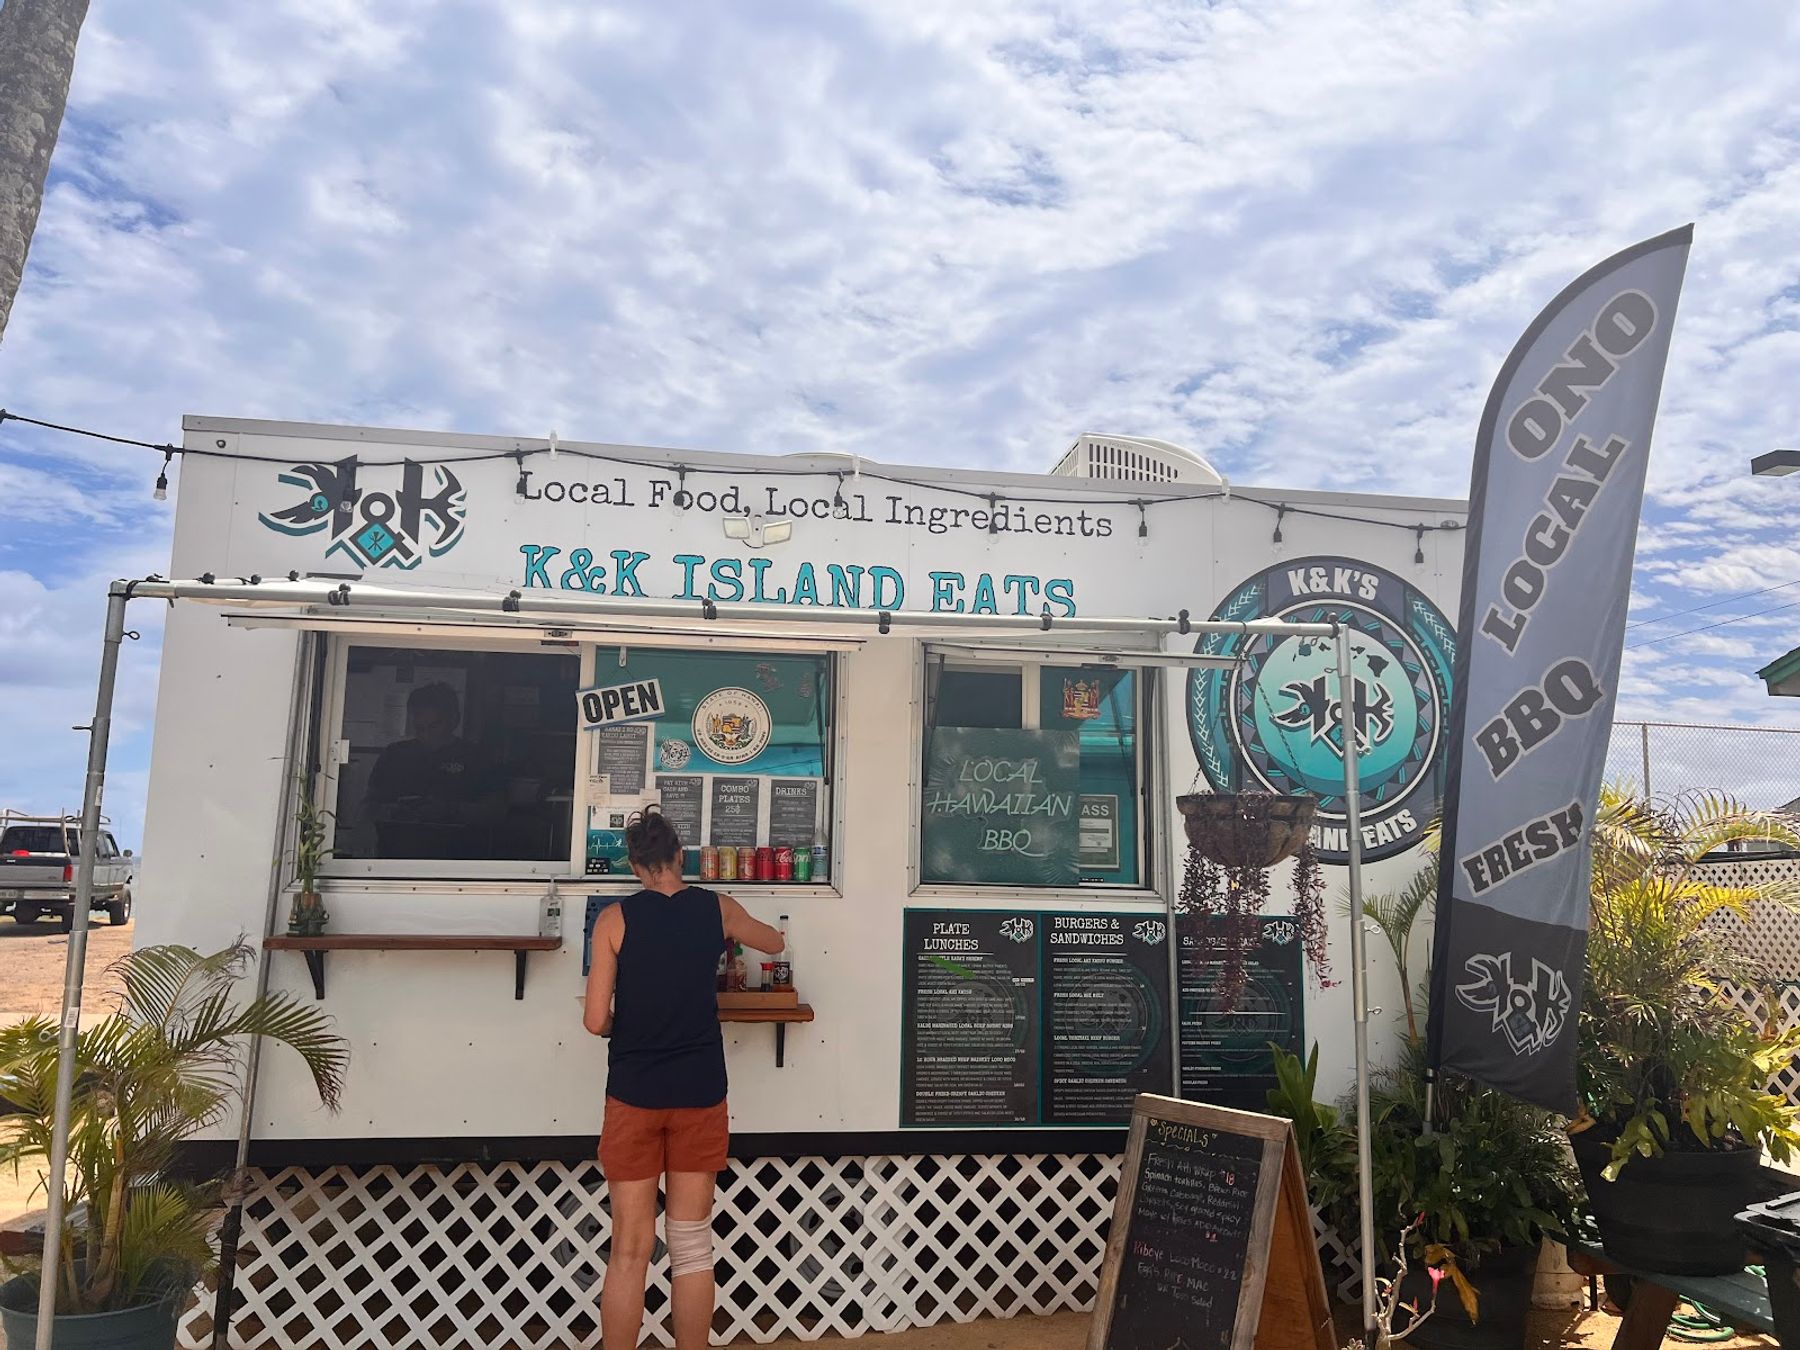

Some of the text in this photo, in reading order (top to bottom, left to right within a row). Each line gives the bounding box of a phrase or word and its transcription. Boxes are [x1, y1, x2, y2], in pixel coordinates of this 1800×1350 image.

[1507, 290, 1658, 461] ONO
[521, 471, 1113, 537] Local Food, Local Ingredients
[1480, 433, 1630, 656] LOCAL
[520, 545, 1076, 618] K&K ISLAND EATS
[1288, 567, 1379, 600] K&K'S
[582, 682, 660, 723] OPEN
[1473, 657, 1603, 782] BBQ
[960, 759, 1043, 784] LOCAL
[719, 795, 751, 804] PLATES
[720, 785, 749, 793] COMBO
[775, 787, 807, 796] DRINKS
[927, 788, 1072, 816] HAWAIIAN
[1081, 804, 1109, 816] ASS
[1361, 808, 1417, 849] EATS
[983, 829, 1045, 858] BBQ
[1459, 802, 1584, 897] FRESH
[933, 923, 970, 934] PLATE
[1054, 917, 1120, 929] BURGERS &
[923, 939, 979, 950] LUNCHES
[1050, 933, 1123, 945] SANDWICHES
